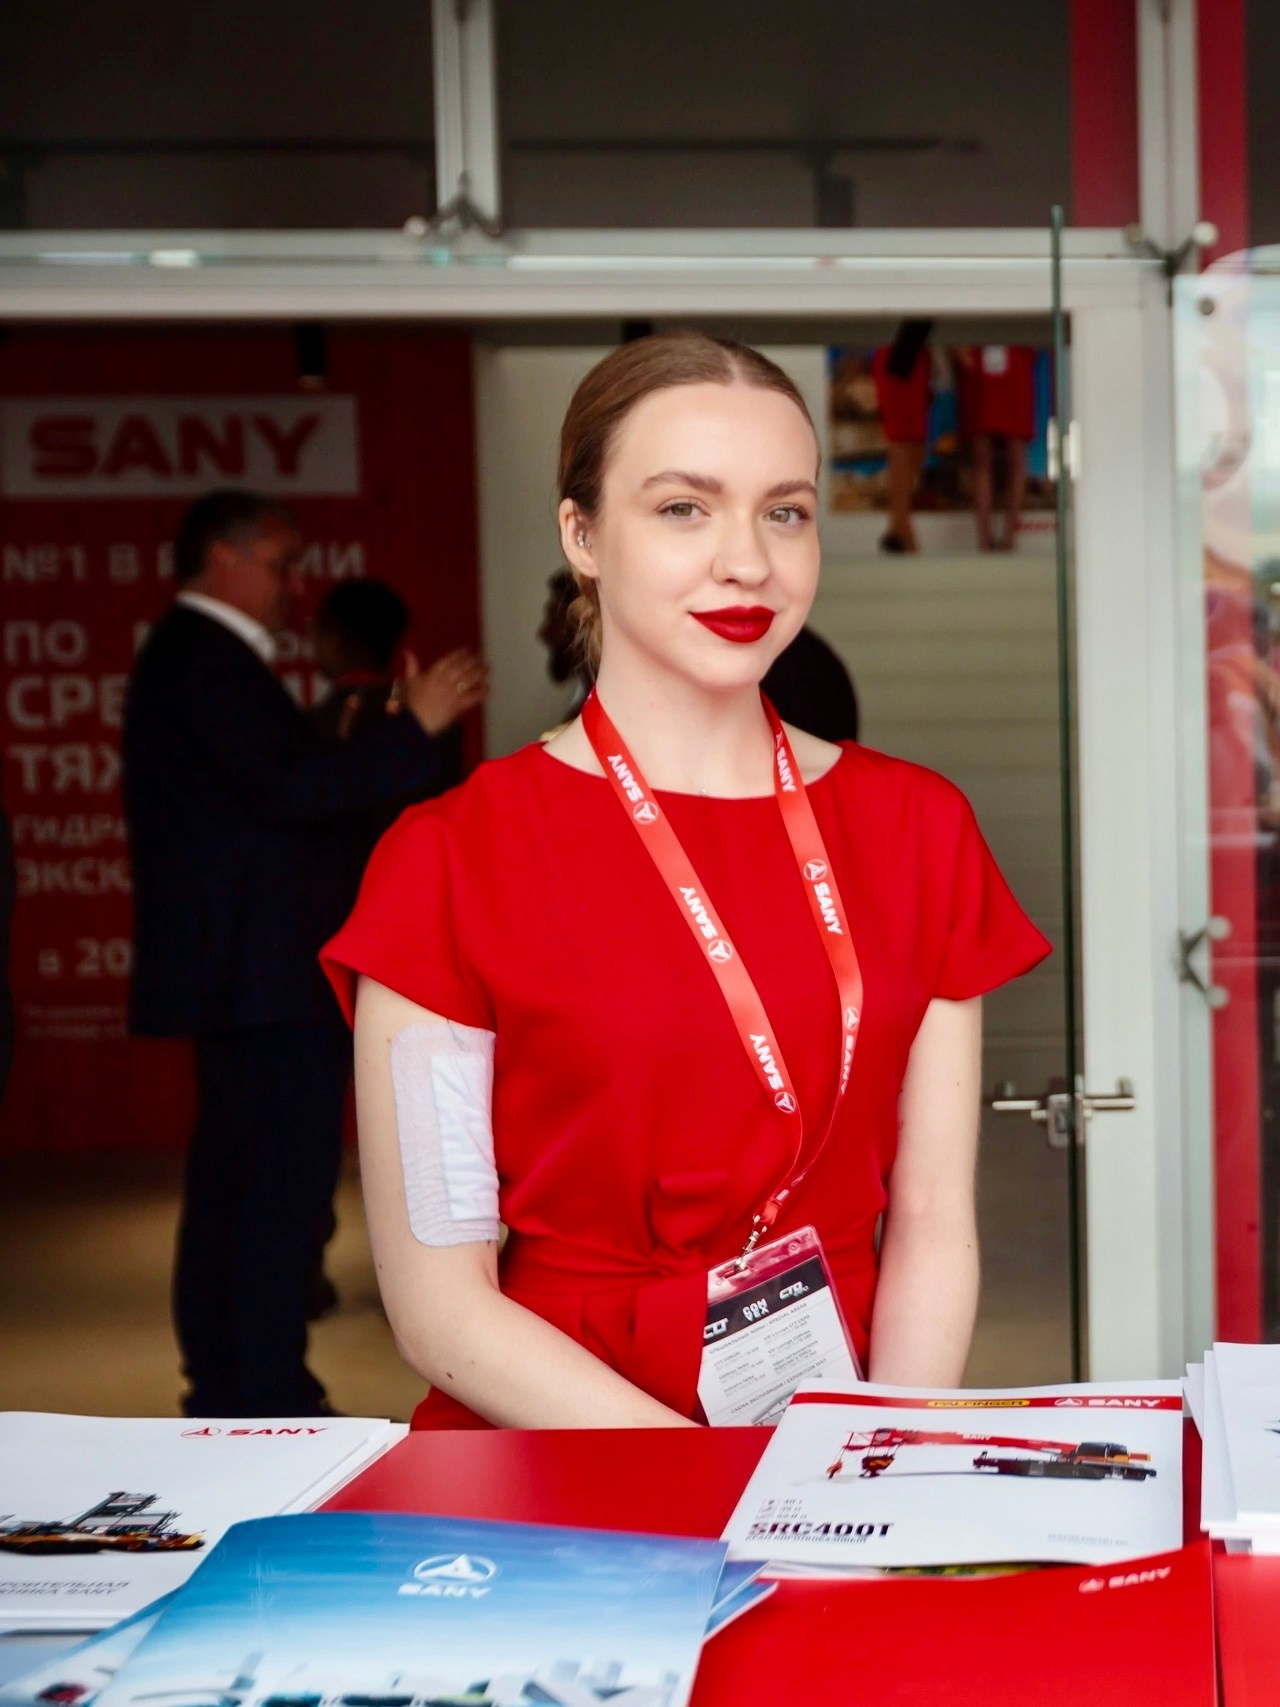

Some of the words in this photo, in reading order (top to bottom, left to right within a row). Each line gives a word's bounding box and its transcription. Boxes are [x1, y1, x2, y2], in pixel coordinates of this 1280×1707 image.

[30, 413, 320, 478] SANY
[106, 543, 139, 582] В
[4, 619, 87, 665] ПО
[608, 754, 644, 802] SANY
[776, 748, 797, 792] SANY
[679, 886, 718, 939] SANY
[814, 882, 843, 936] SANY
[75, 936, 134, 979] 20
[750, 1033, 784, 1090] SANY
[840, 1035, 854, 1095] SANY
[1088, 1399, 1161, 1408] SANY
[226, 1427, 328, 1436] SANY
[749, 1521, 895, 1538] SRC400T
[397, 1583, 492, 1599] SANY
[1108, 1566, 1171, 1589] SANY
